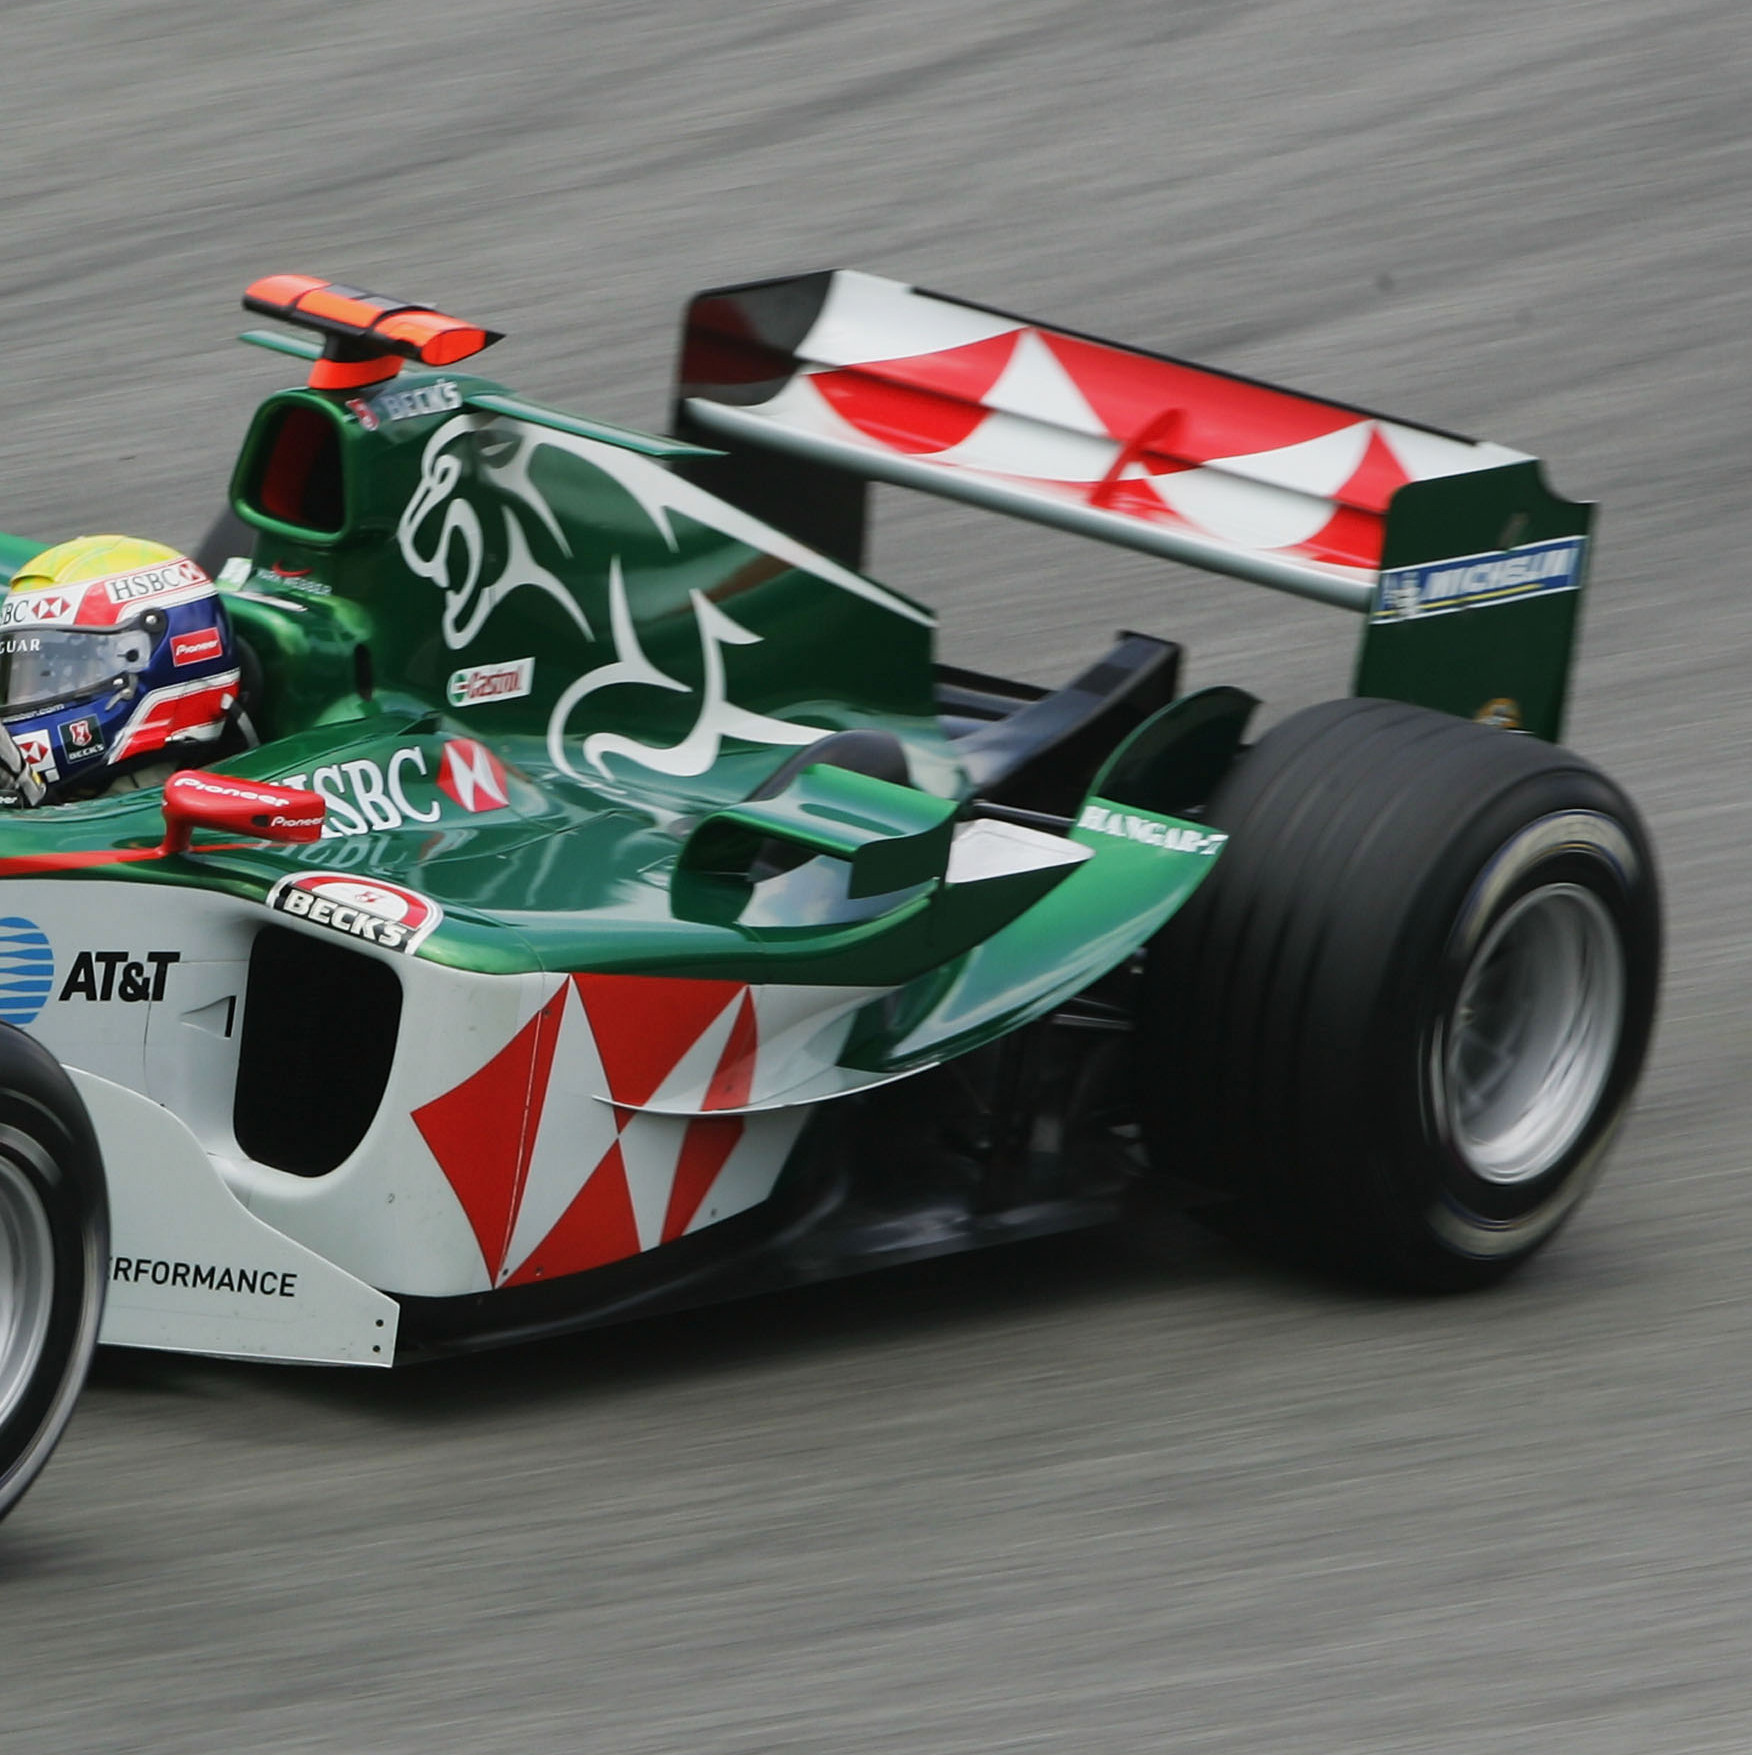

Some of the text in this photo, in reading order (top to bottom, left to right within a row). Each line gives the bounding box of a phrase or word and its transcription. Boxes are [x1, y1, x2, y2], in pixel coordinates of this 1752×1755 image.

[111, 568, 180, 600] HSBC
[174, 777, 290, 807] Pioneer
[263, 744, 442, 840] SBC
[270, 815, 324, 828] Pioneer
[283, 889, 409, 948] BECK'S
[58, 951, 181, 1002] AT&T
[108, 1256, 298, 1298] RFORMANCE
